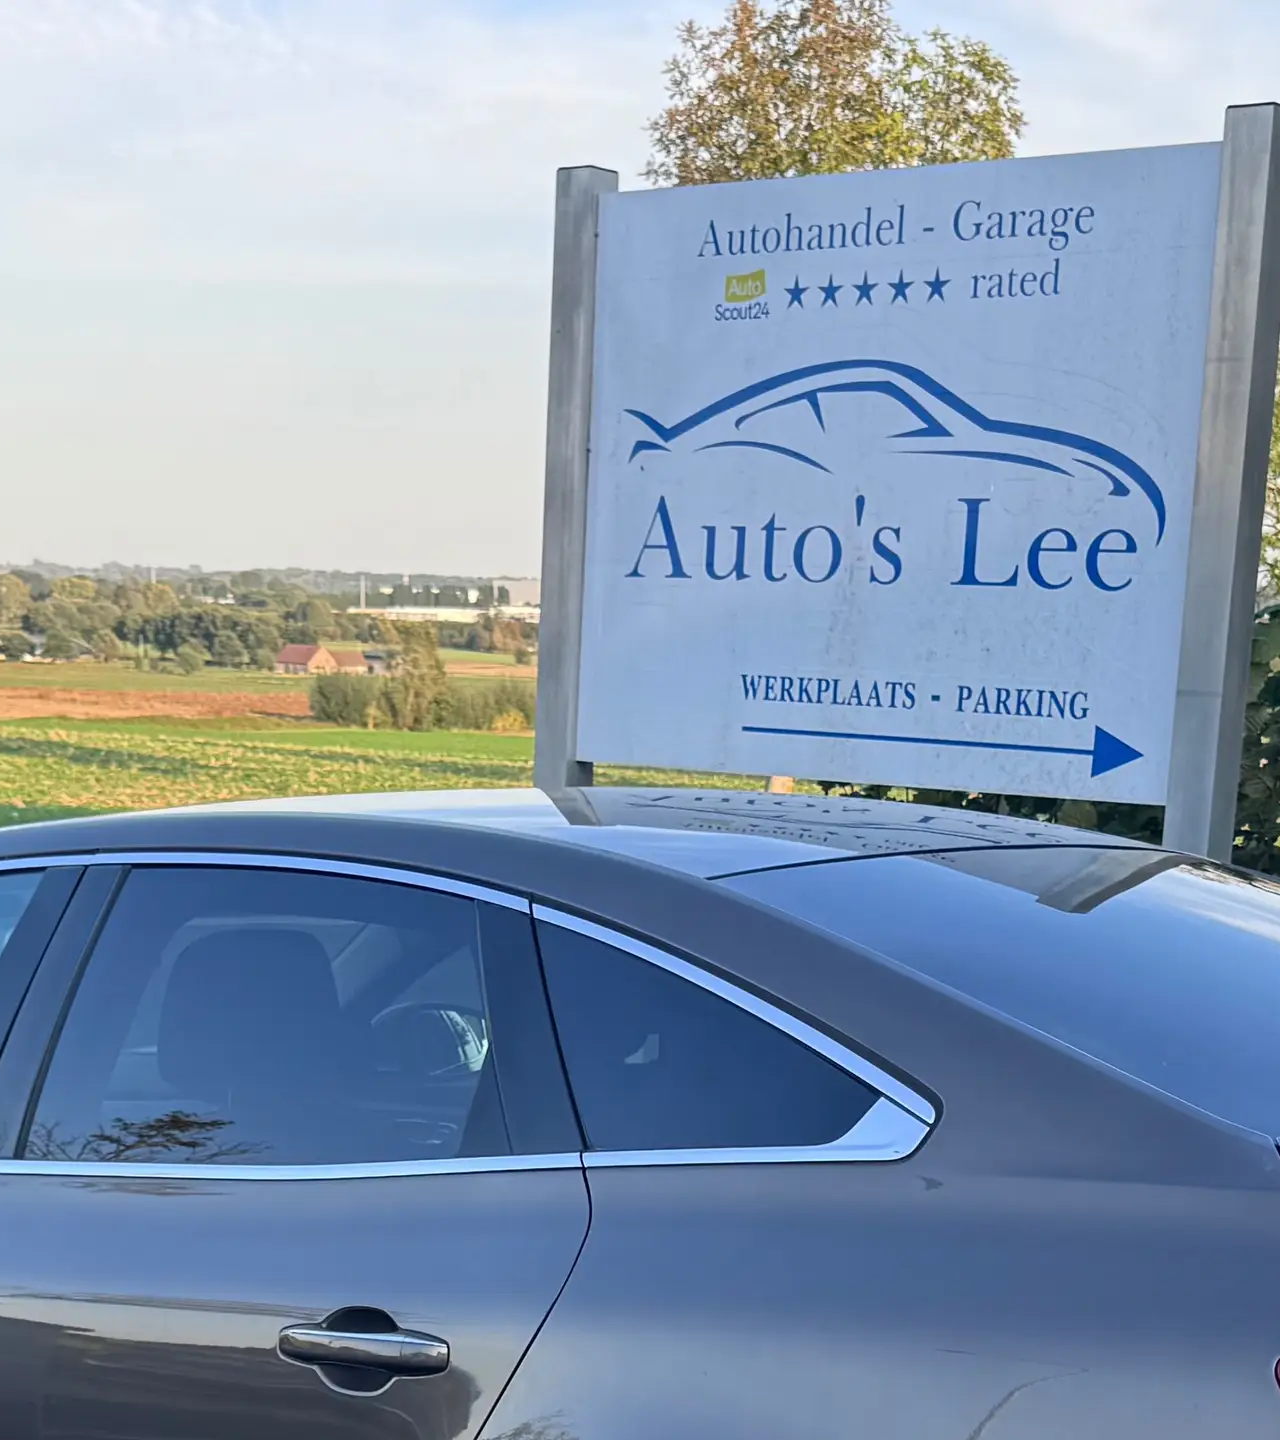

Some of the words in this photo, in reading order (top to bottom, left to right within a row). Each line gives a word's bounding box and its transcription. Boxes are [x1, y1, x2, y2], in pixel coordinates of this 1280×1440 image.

[697, 204, 905, 258] Autohandel
[952, 200, 1096, 251] Garage
[727, 277, 763, 298] Auto
[970, 257, 1060, 300] rated
[714, 301, 770, 321] Scout24
[624, 494, 903, 586] Auto's
[950, 497, 1138, 592] Lee
[740, 674, 916, 711] WERKPLAATS
[955, 684, 1090, 721] PARKING
